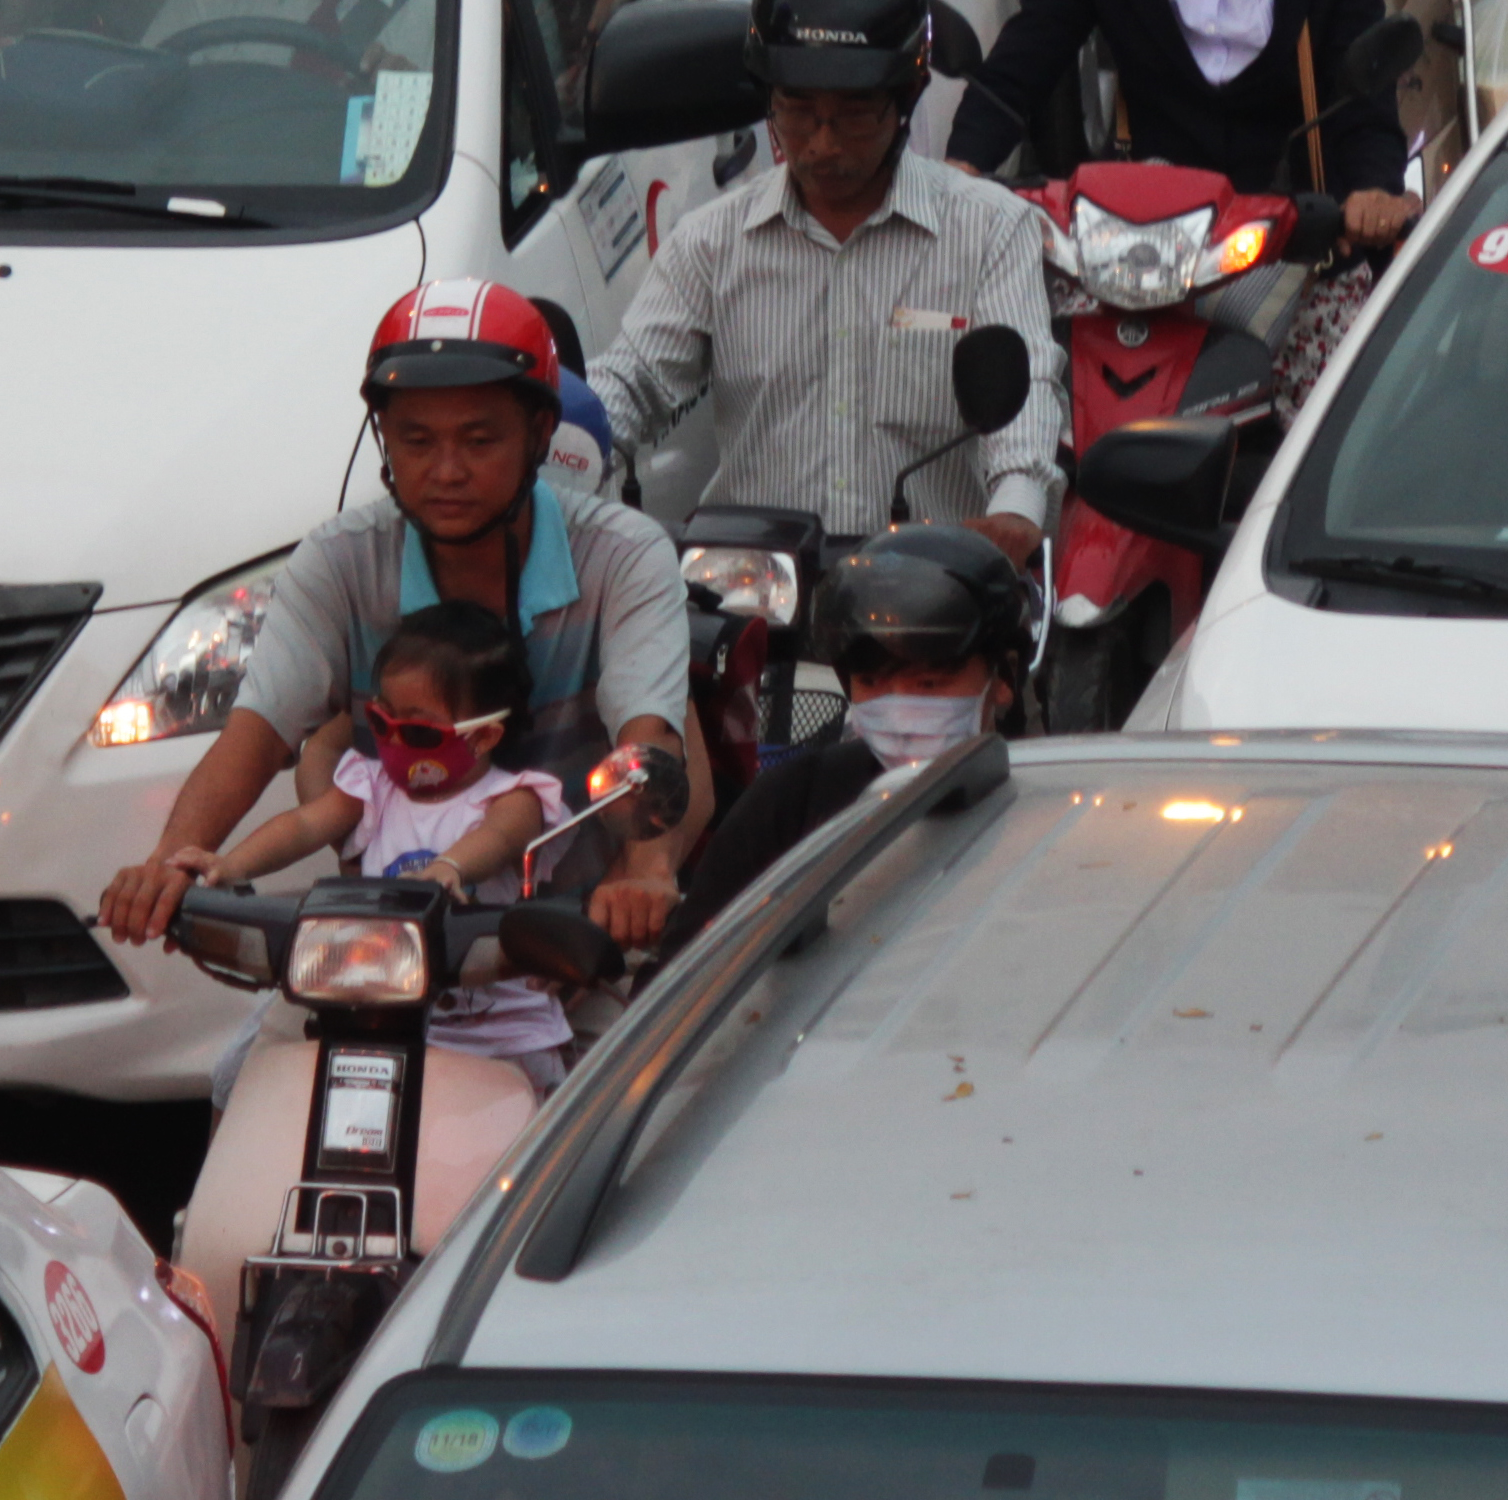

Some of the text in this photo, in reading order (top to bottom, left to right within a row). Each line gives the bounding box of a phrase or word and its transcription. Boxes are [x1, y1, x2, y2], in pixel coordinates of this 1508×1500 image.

[795, 27, 869, 45] HONDA
[336, 1064, 390, 1076] HONDA
[48, 1271, 99, 1364] 3266
